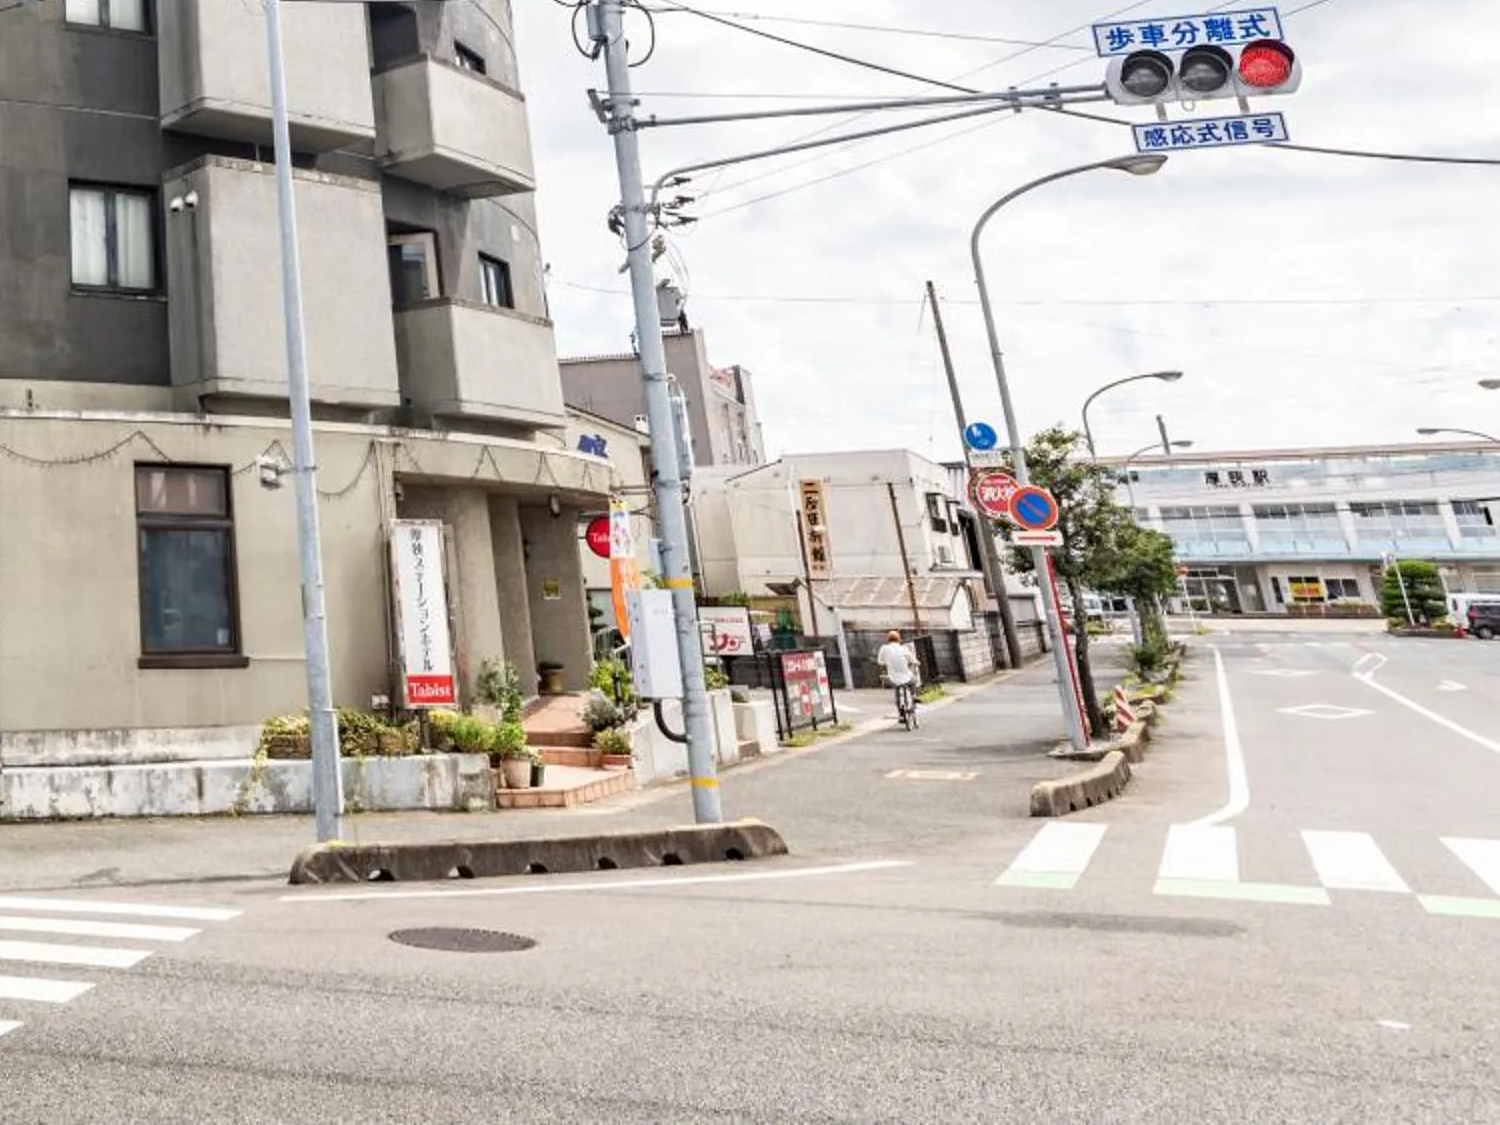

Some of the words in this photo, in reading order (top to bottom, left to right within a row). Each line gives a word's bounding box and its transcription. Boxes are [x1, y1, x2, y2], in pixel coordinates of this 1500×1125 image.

[1106, 15, 1270, 51] 歩車分離式
[1144, 119, 1275, 148] 感応式信号
[410, 683, 451, 697] Tabist
